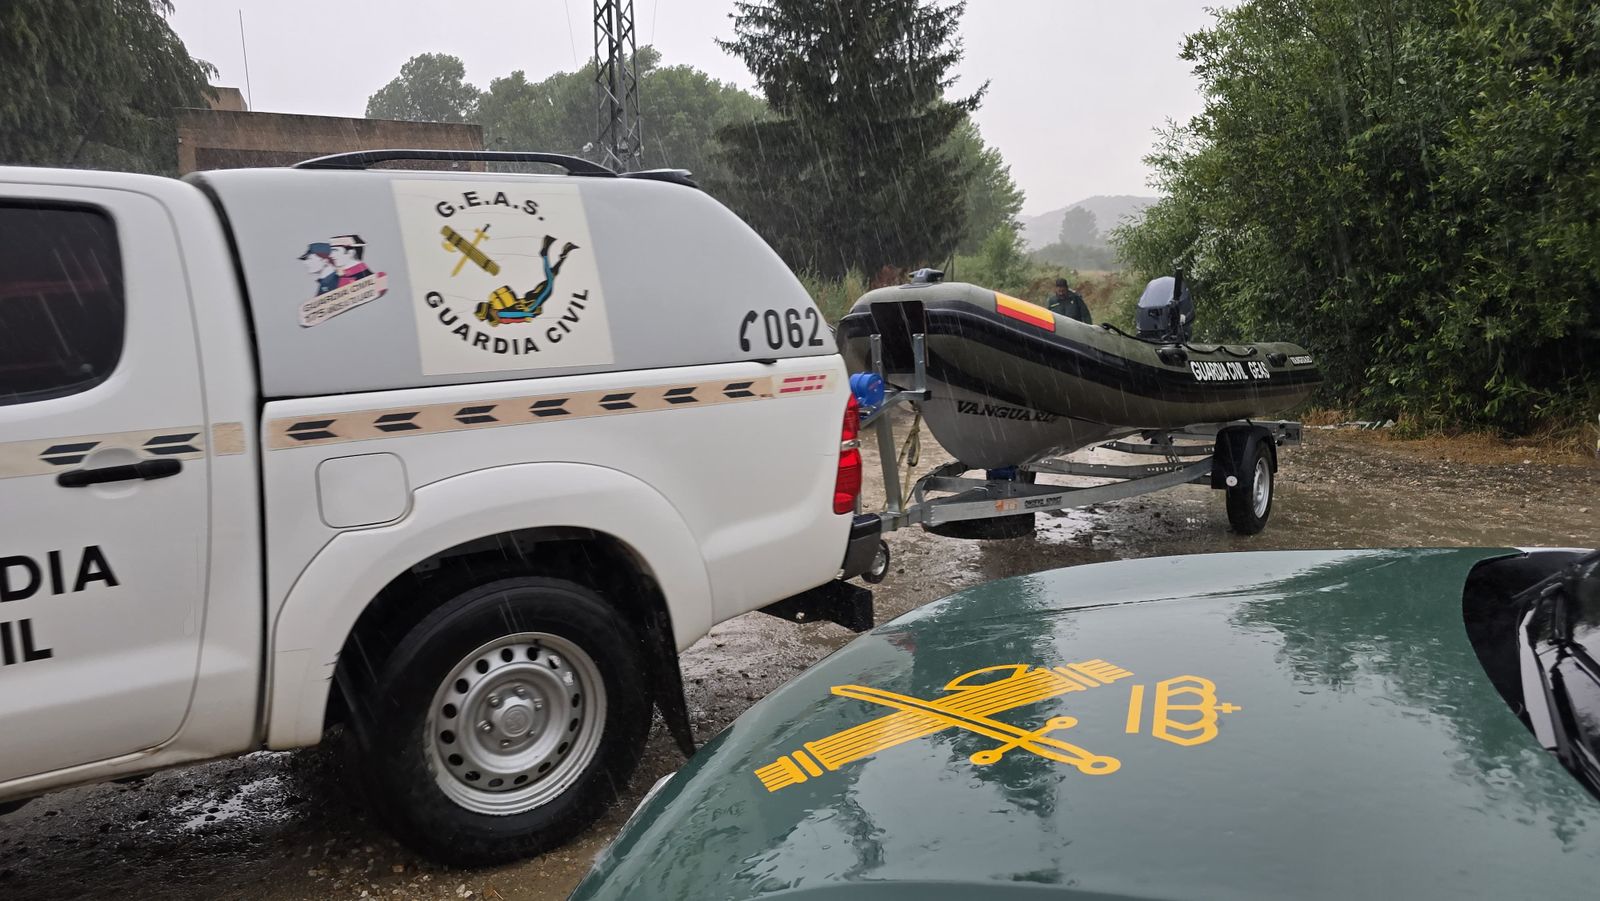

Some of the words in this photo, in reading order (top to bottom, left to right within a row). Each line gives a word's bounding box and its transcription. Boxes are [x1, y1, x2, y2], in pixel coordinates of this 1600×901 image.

[436, 191, 546, 221] G.E.A.S.
[425, 291, 541, 356] GUARDIA
[545, 288, 590, 344] CIVIL
[764, 307, 823, 350] 062
[1190, 361, 1230, 381] GUARDIA
[1226, 361, 1249, 380] CIVIL
[1248, 361, 1270, 379] GEAS
